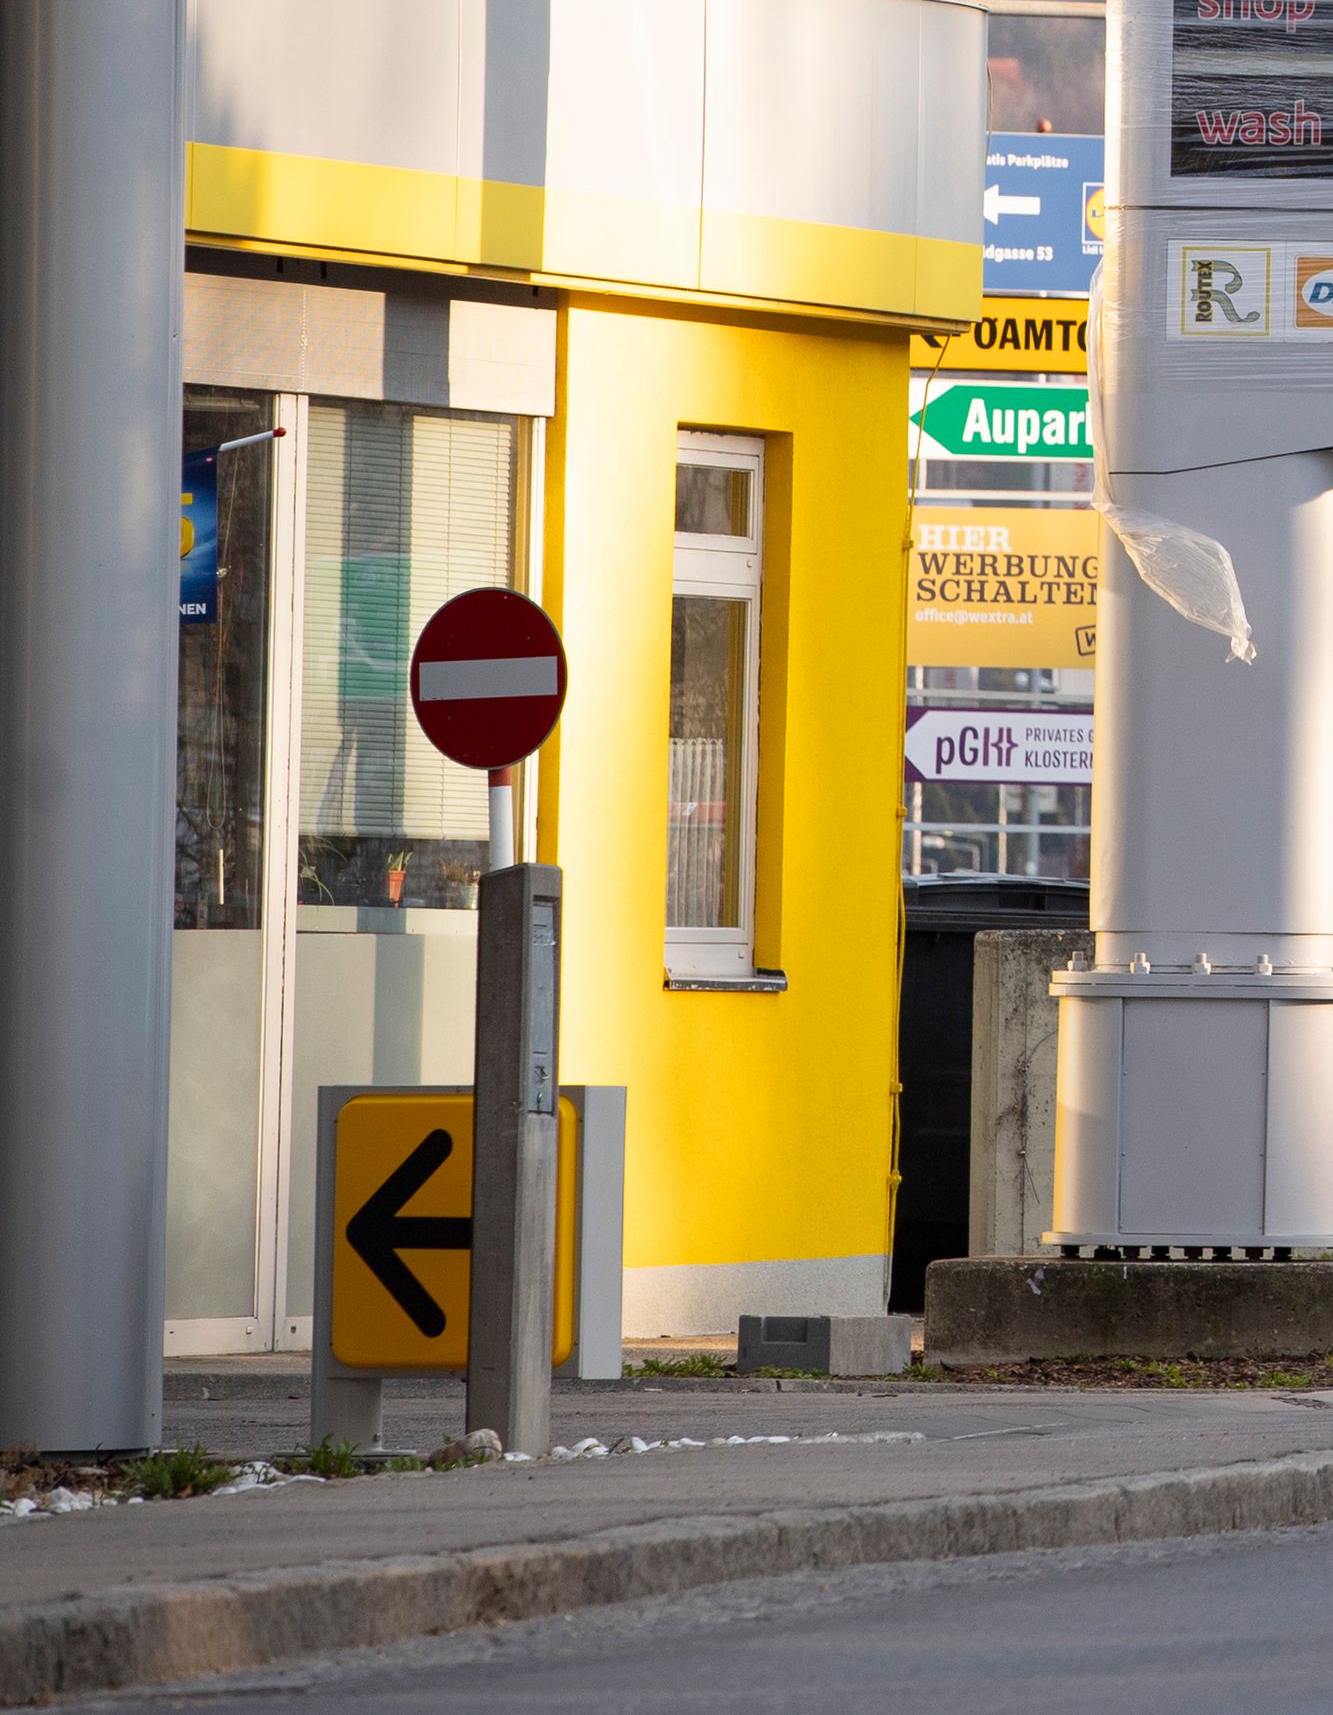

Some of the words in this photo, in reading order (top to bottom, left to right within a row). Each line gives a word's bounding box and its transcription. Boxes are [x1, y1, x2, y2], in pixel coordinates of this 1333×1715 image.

[1198, 100, 1322, 146] wash
[1196, 260, 1213, 322] ROUTEX
[918, 524, 1011, 552] HIER
[918, 553, 1098, 579] WERBUNG
[915, 608, 1033, 626] office@wextra.at
[1026, 727, 1084, 743] PRIVATES
